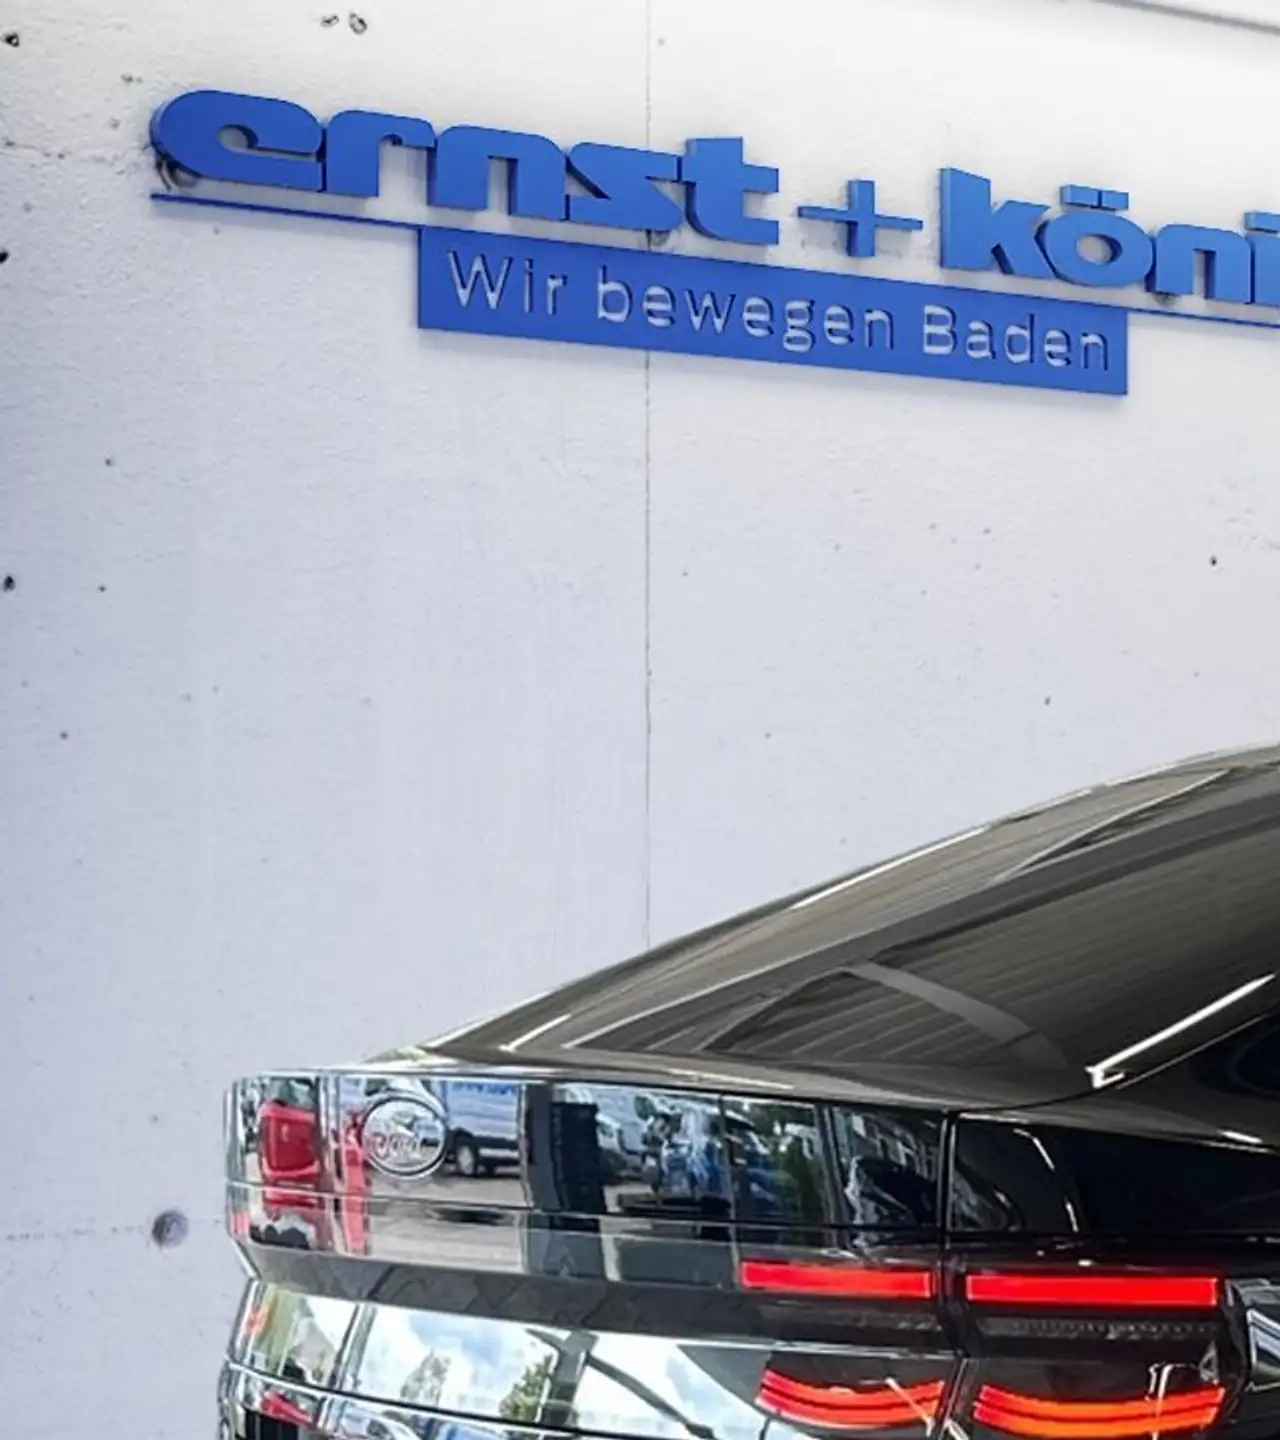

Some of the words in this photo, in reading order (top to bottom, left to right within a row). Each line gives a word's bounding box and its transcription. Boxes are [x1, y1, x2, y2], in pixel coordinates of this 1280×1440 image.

[446, 248, 566, 319] Wir
[597, 264, 896, 352] bewegen
[921, 303, 1112, 372] Baden
